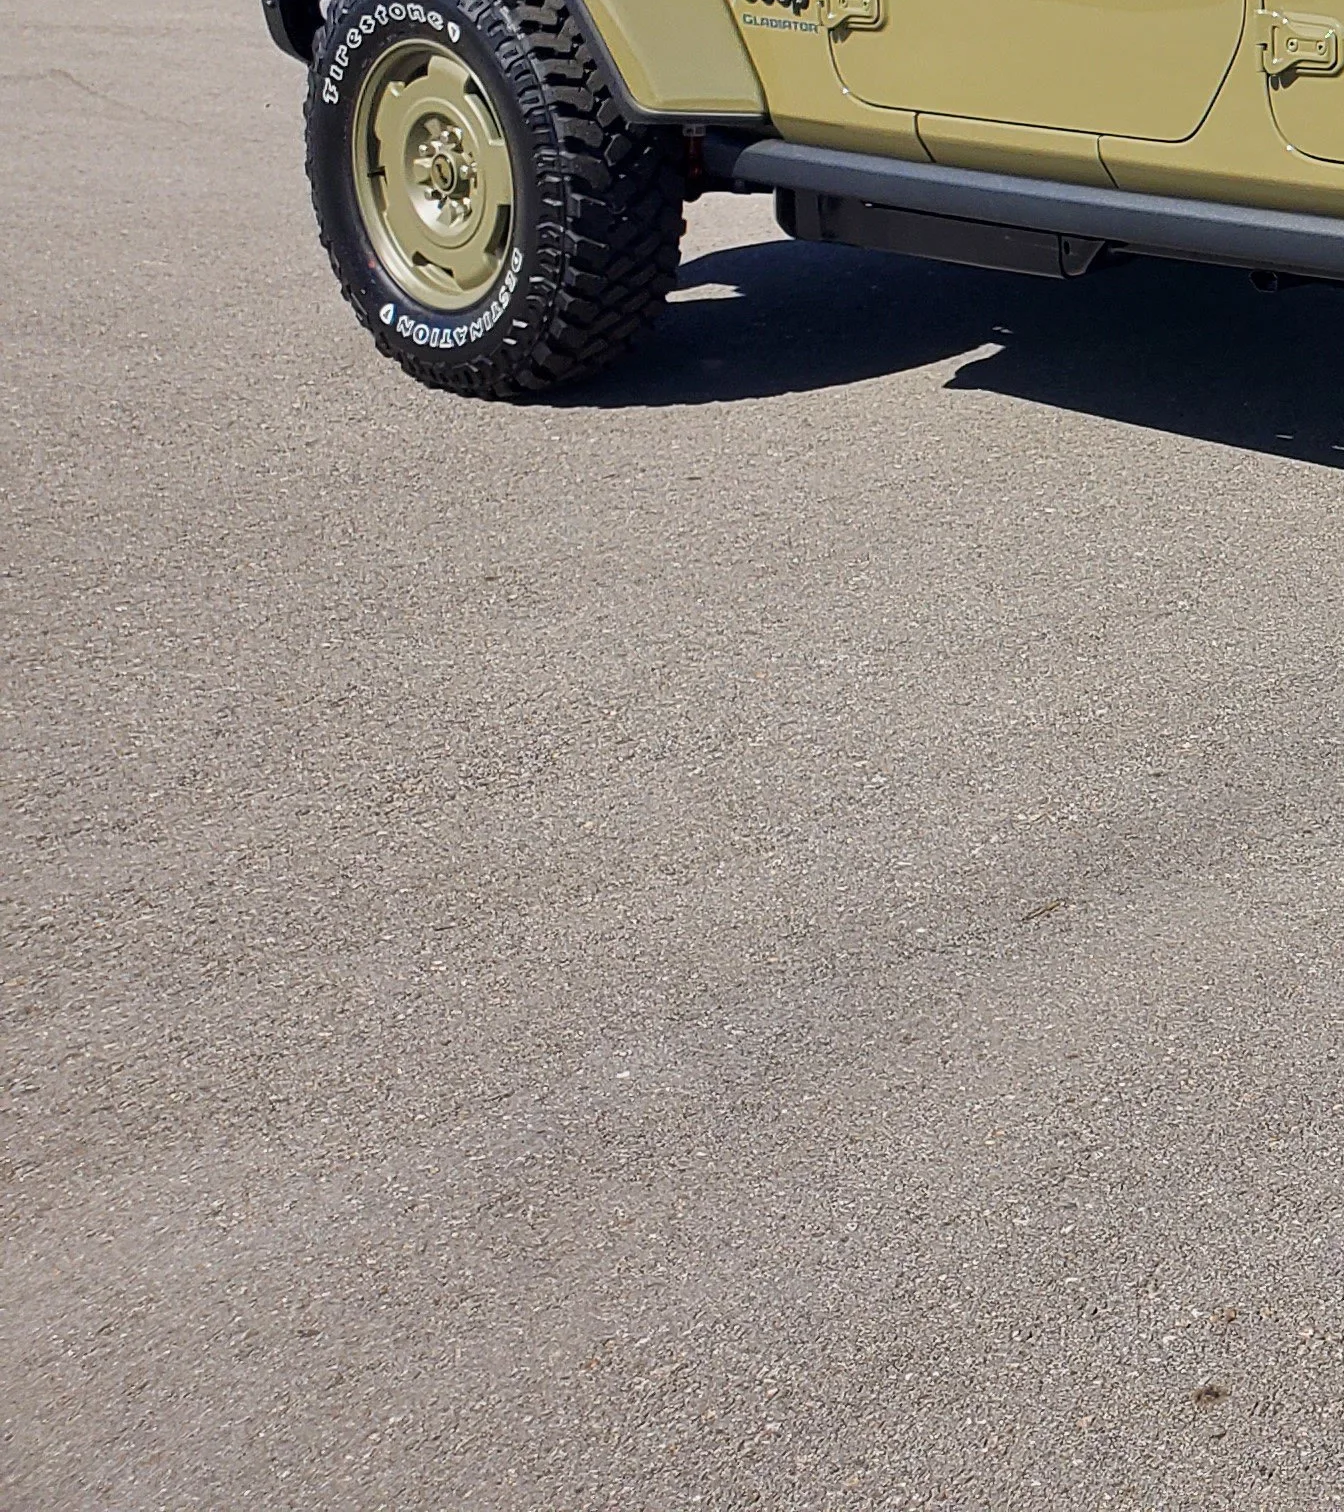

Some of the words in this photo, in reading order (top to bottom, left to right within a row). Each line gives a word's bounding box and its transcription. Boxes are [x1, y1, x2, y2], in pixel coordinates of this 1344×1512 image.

[323, 2, 443, 105] Firestone
[742, 13, 818, 33] GLADIATOR
[396, 247, 523, 349] DESTINATION
